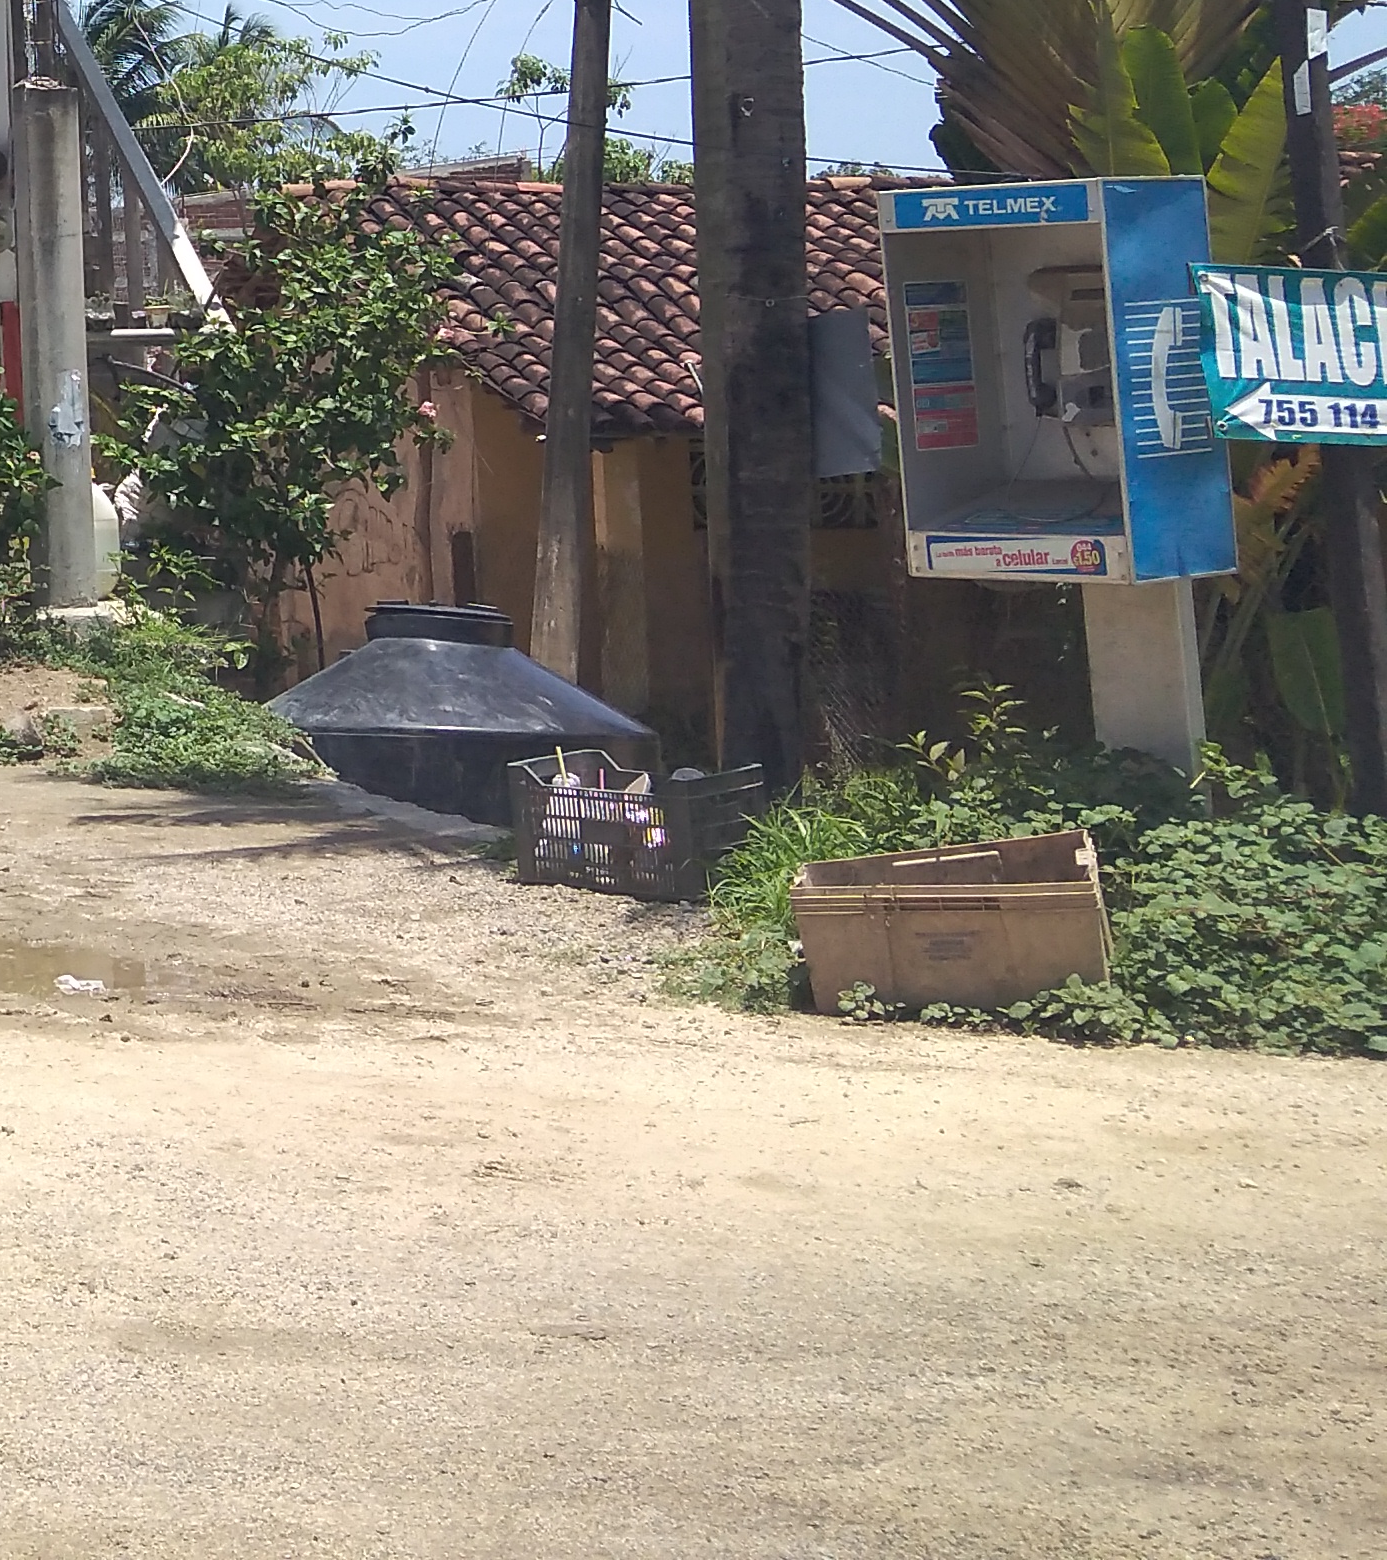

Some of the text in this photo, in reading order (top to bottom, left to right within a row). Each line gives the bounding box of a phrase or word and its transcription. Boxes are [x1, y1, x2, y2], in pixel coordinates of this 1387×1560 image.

[964, 196, 1057, 216] TELMEX
[1258, 398, 1380, 429] 755 114
[1002, 549, 1050, 567] celular
